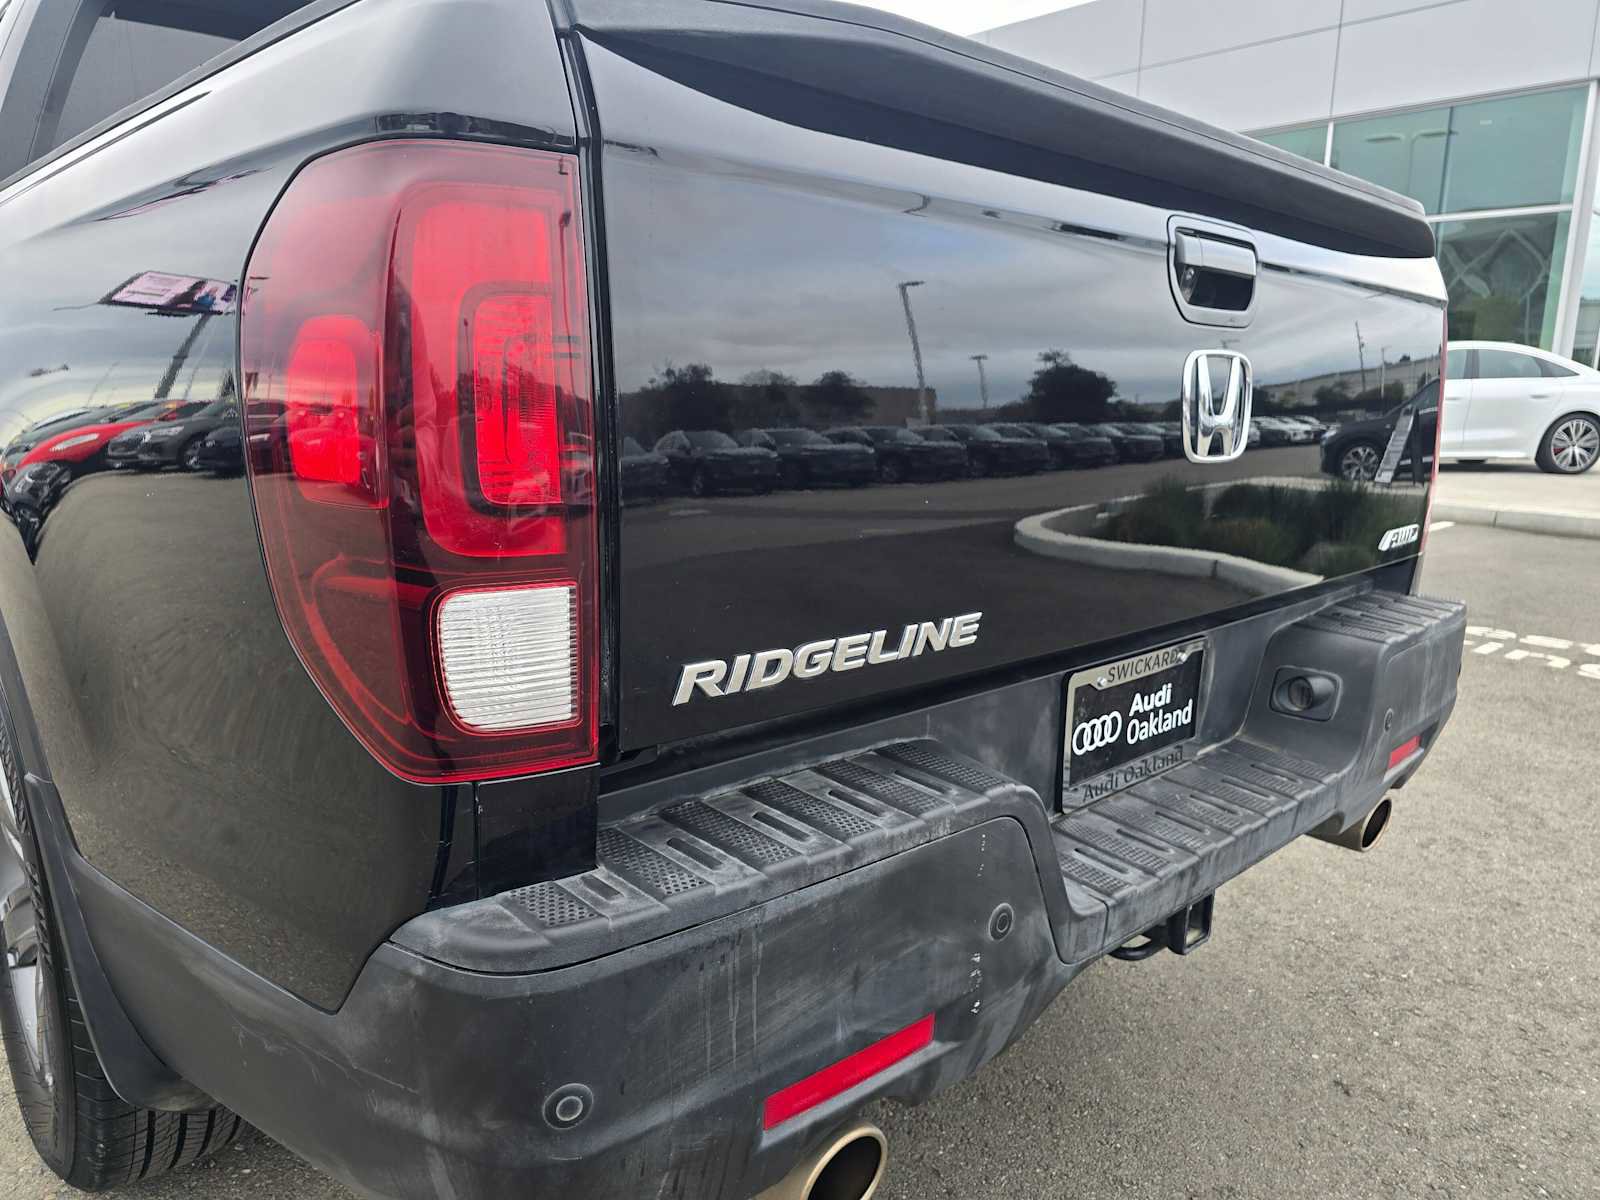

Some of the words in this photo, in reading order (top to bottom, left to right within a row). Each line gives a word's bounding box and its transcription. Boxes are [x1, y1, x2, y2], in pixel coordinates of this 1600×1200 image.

[672, 611, 983, 707] RIDGELINE
[1107, 647, 1180, 683] SWICKARD
[1127, 698, 1193, 744] Oakland
[1129, 682, 1172, 716] Audi
[1082, 773, 1118, 802] Audi
[1124, 745, 1183, 783] Oakland
